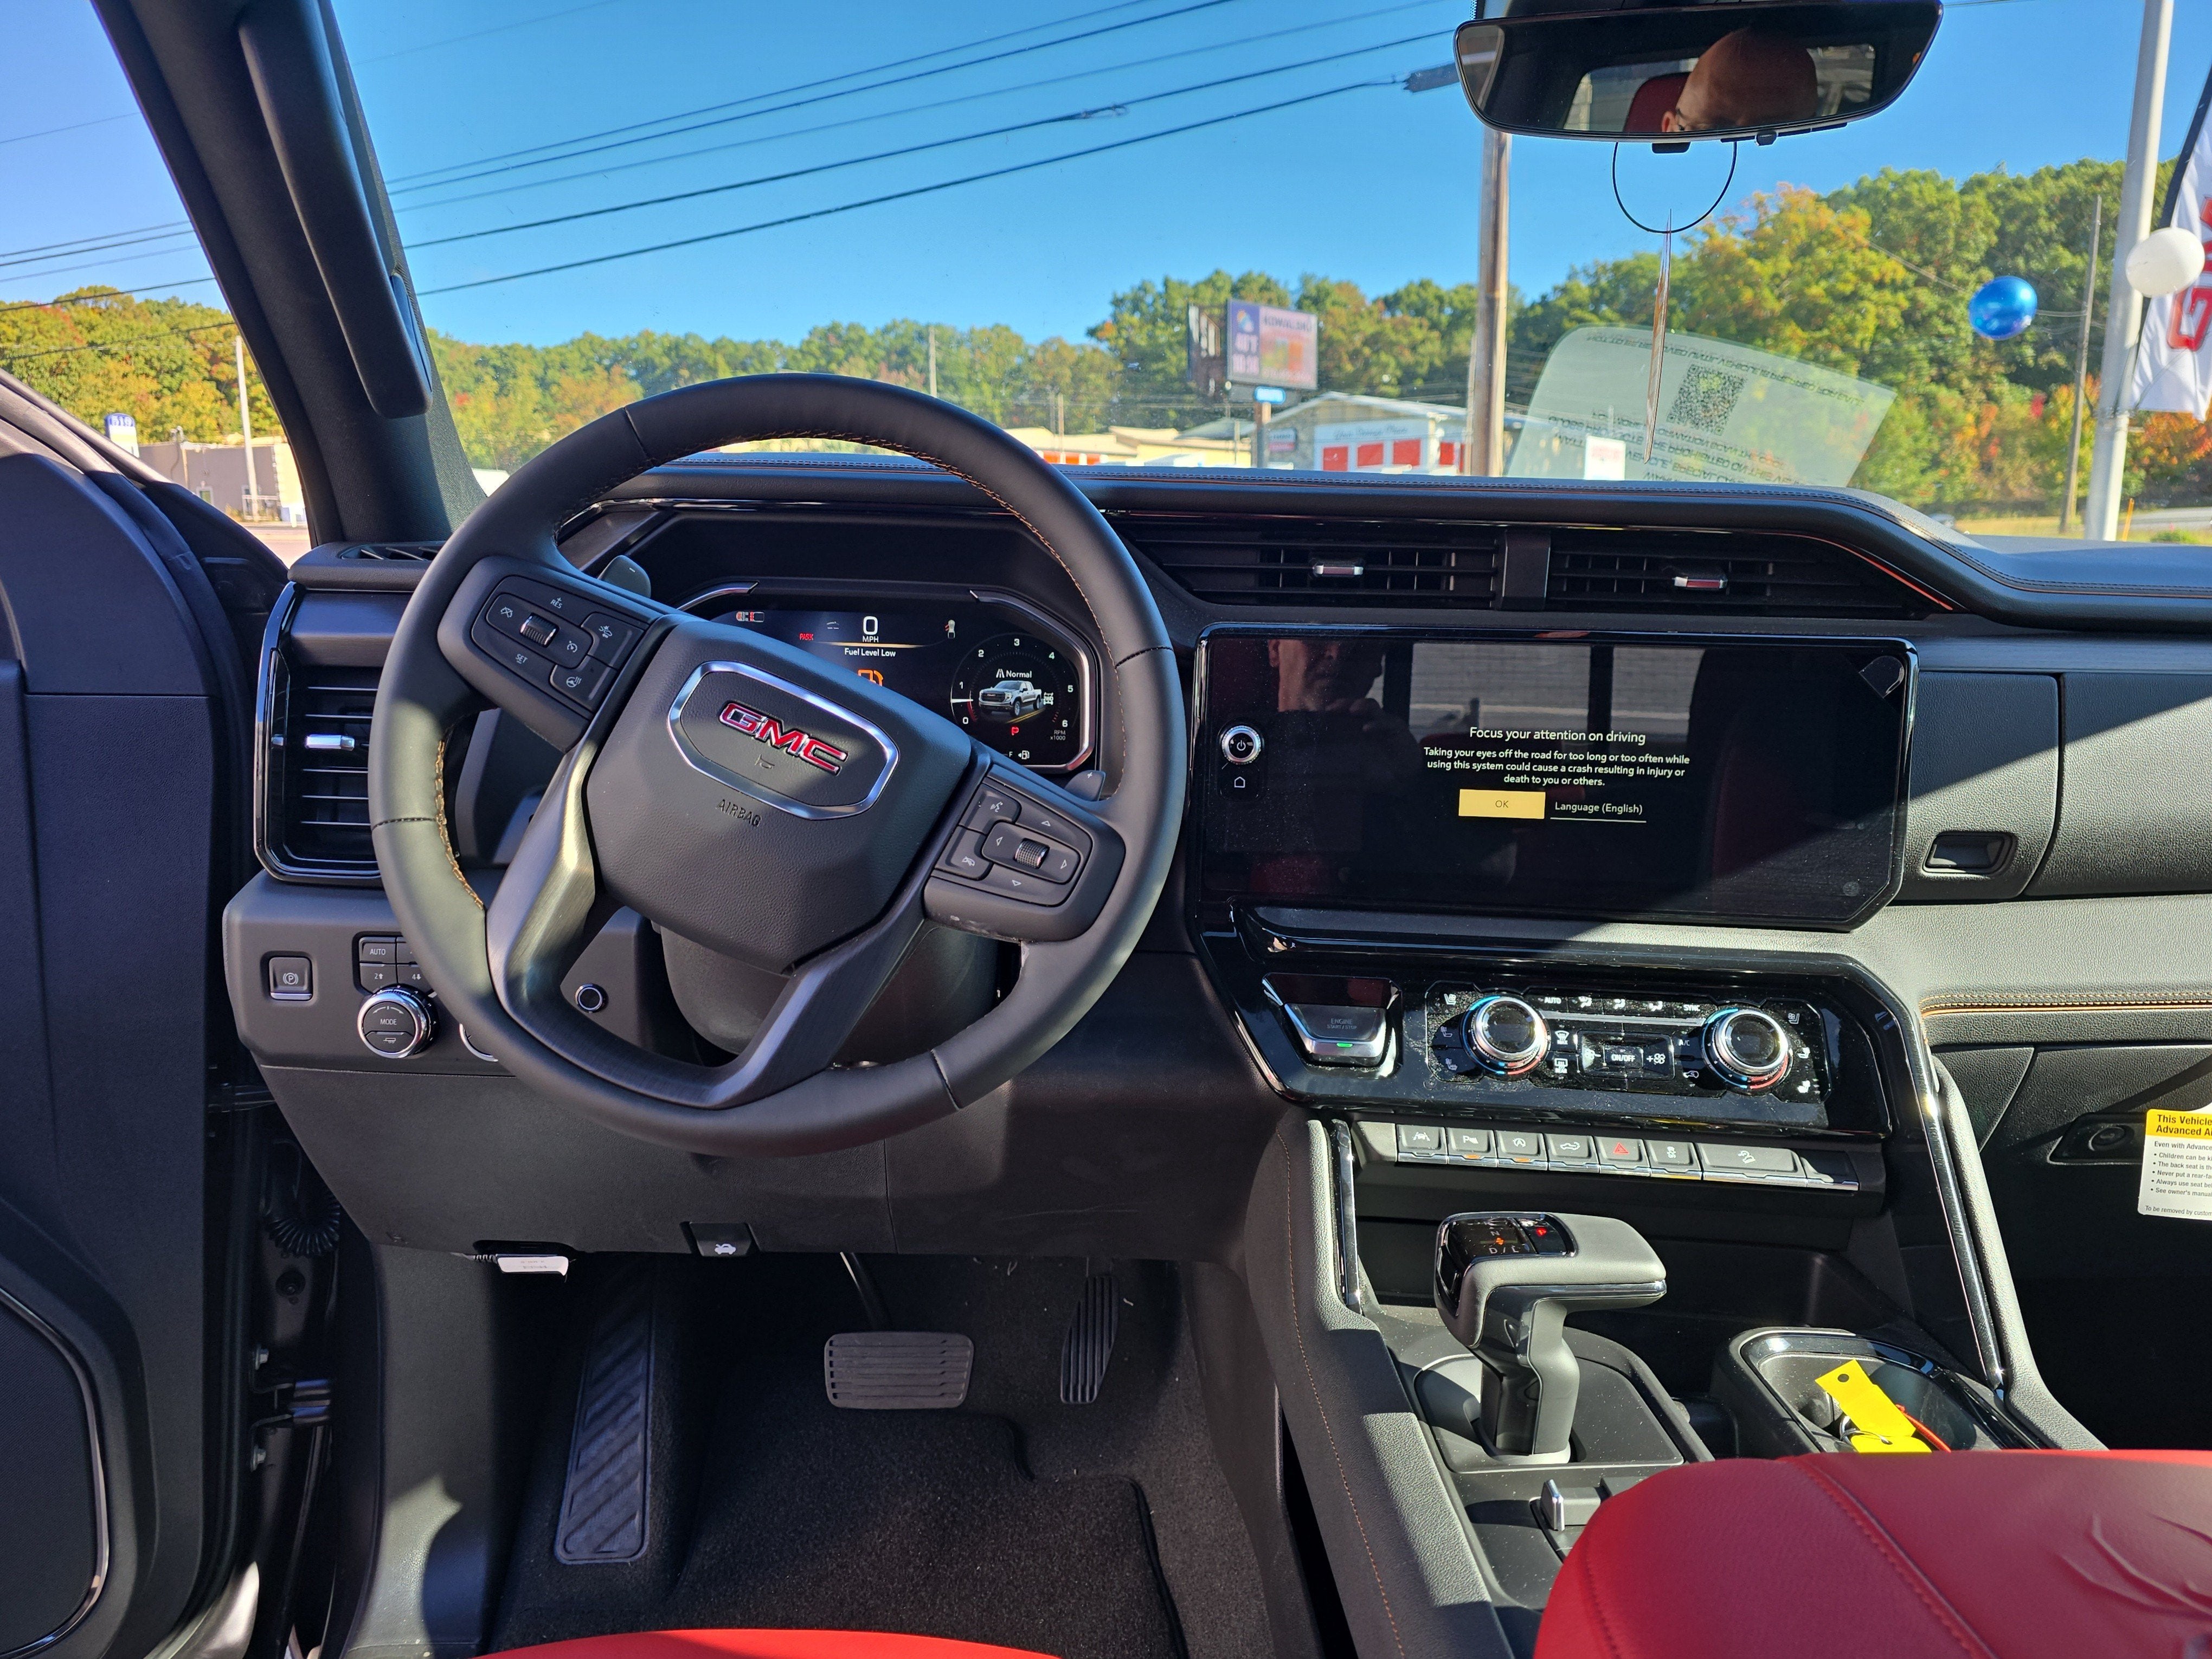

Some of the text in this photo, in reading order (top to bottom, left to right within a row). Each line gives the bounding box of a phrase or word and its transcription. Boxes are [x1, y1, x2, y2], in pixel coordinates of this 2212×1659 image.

[863, 616, 878, 635] 0
[1014, 638, 1020, 646] 3
[845, 647, 896, 657] Fuel Level Low
[978, 650, 984, 658] 2
[1049, 652, 1054, 660] 4
[1006, 670, 1032, 678] Normal
[962, 716, 969, 724] 0
[1062, 719, 1068, 728] 6
[719, 703, 849, 776] GMC
[1470, 726, 1646, 745] Focus your attention on driving
[1424, 747, 1452, 758] Taking
[1454, 750, 1475, 758] your
[1476, 750, 1497, 759] eyes
[1499, 749, 1513, 758] off
[1514, 749, 1529, 758] the
[1531, 750, 1552, 760] road
[1554, 750, 1567, 760] for
[1569, 753, 1585, 761] too
[1586, 751, 1607, 763] long
[1621, 754, 1637, 762] too
[1638, 753, 1664, 763] often
[1666, 754, 1690, 764] while
[1427, 760, 1452, 771] using
[1454, 760, 1470, 769] this
[1472, 762, 1504, 772] system
[1506, 762, 1531, 771] could
[1532, 764, 1559, 772] cause
[1568, 763, 1593, 773] crash
[1594, 764, 1635, 776] resulting
[1636, 766, 1645, 775] in
[1647, 766, 1673, 779] injury
[1674, 768, 1686, 776] or
[1503, 774, 1529, 783] death
[1532, 775, 1541, 784] to
[1542, 777, 1560, 786] you
[1573, 776, 1605, 786] others.
[1495, 800, 1509, 808] OK
[1555, 801, 1643, 815] Language (English)
[717, 799, 762, 827] AIRBAG
[1611, 1054, 1635, 1062] ON/OFF
[2157, 1114, 2212, 1126] This Vehicle
[2156, 1124, 2202, 1135] Advanced
